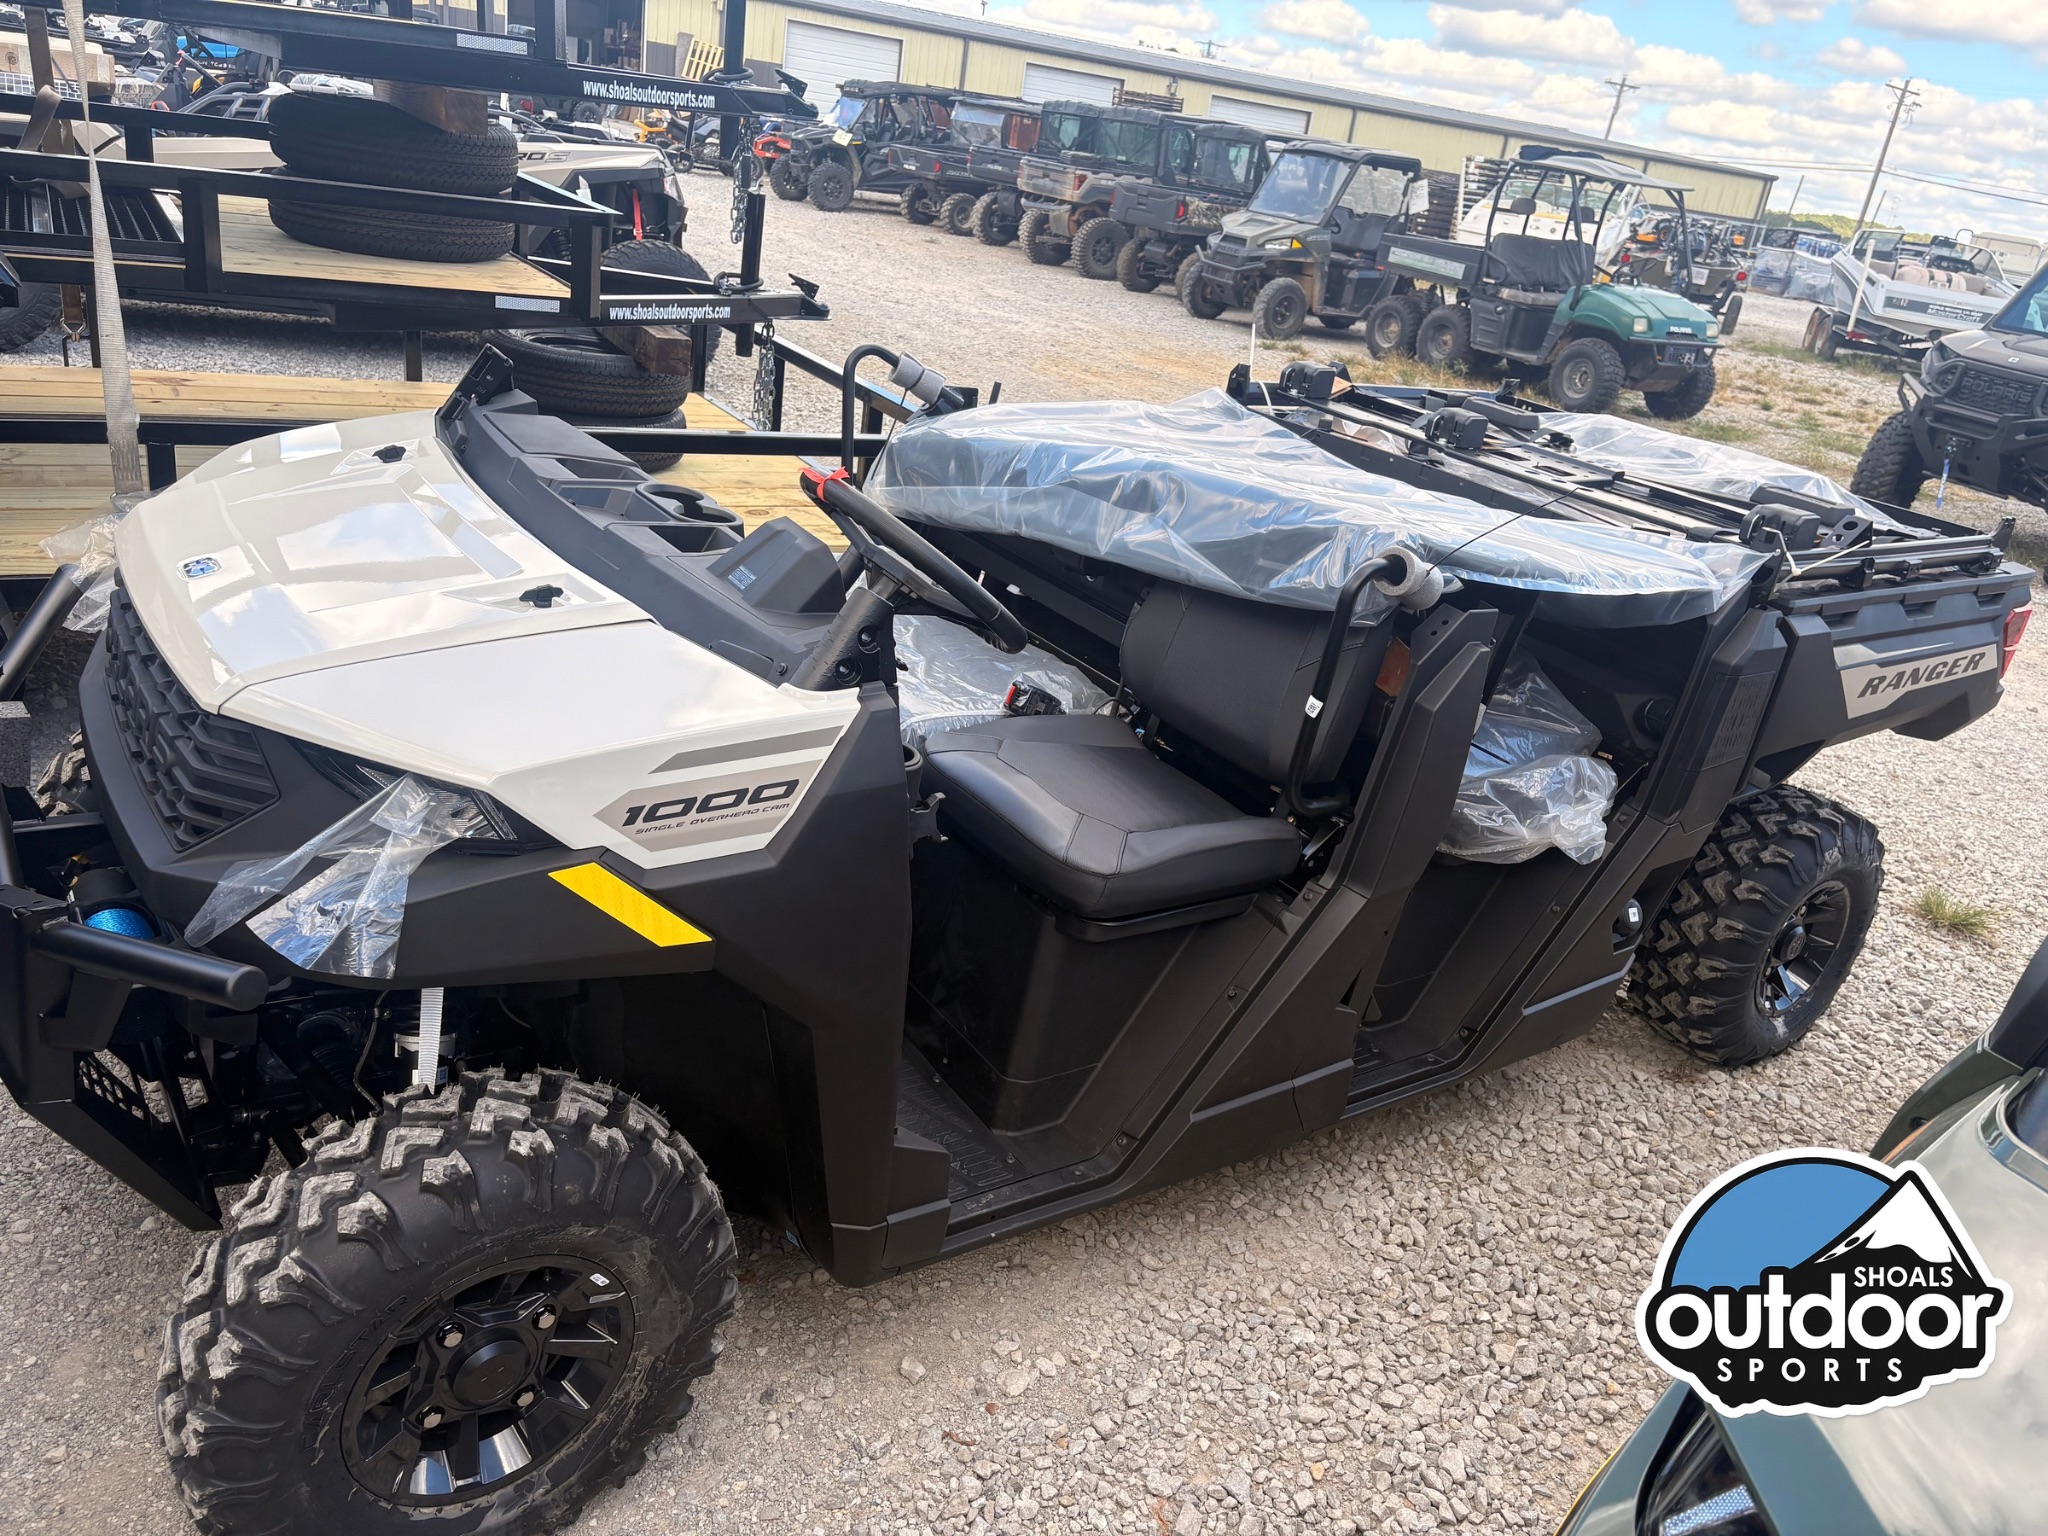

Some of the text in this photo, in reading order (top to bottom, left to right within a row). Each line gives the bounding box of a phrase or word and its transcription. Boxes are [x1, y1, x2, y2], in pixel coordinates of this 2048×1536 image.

[583, 80, 715, 109] www.shoalsoutdoorsports.com
[517, 152, 547, 161] RO
[609, 303, 731, 323] www.shoalsoutdoorsports.com
[1961, 377, 2032, 402] POLARIS
[1857, 651, 1986, 698] RANGER
[622, 778, 800, 827] 1000
[635, 803, 790, 835] SINGLE OVERHEAD CAM
